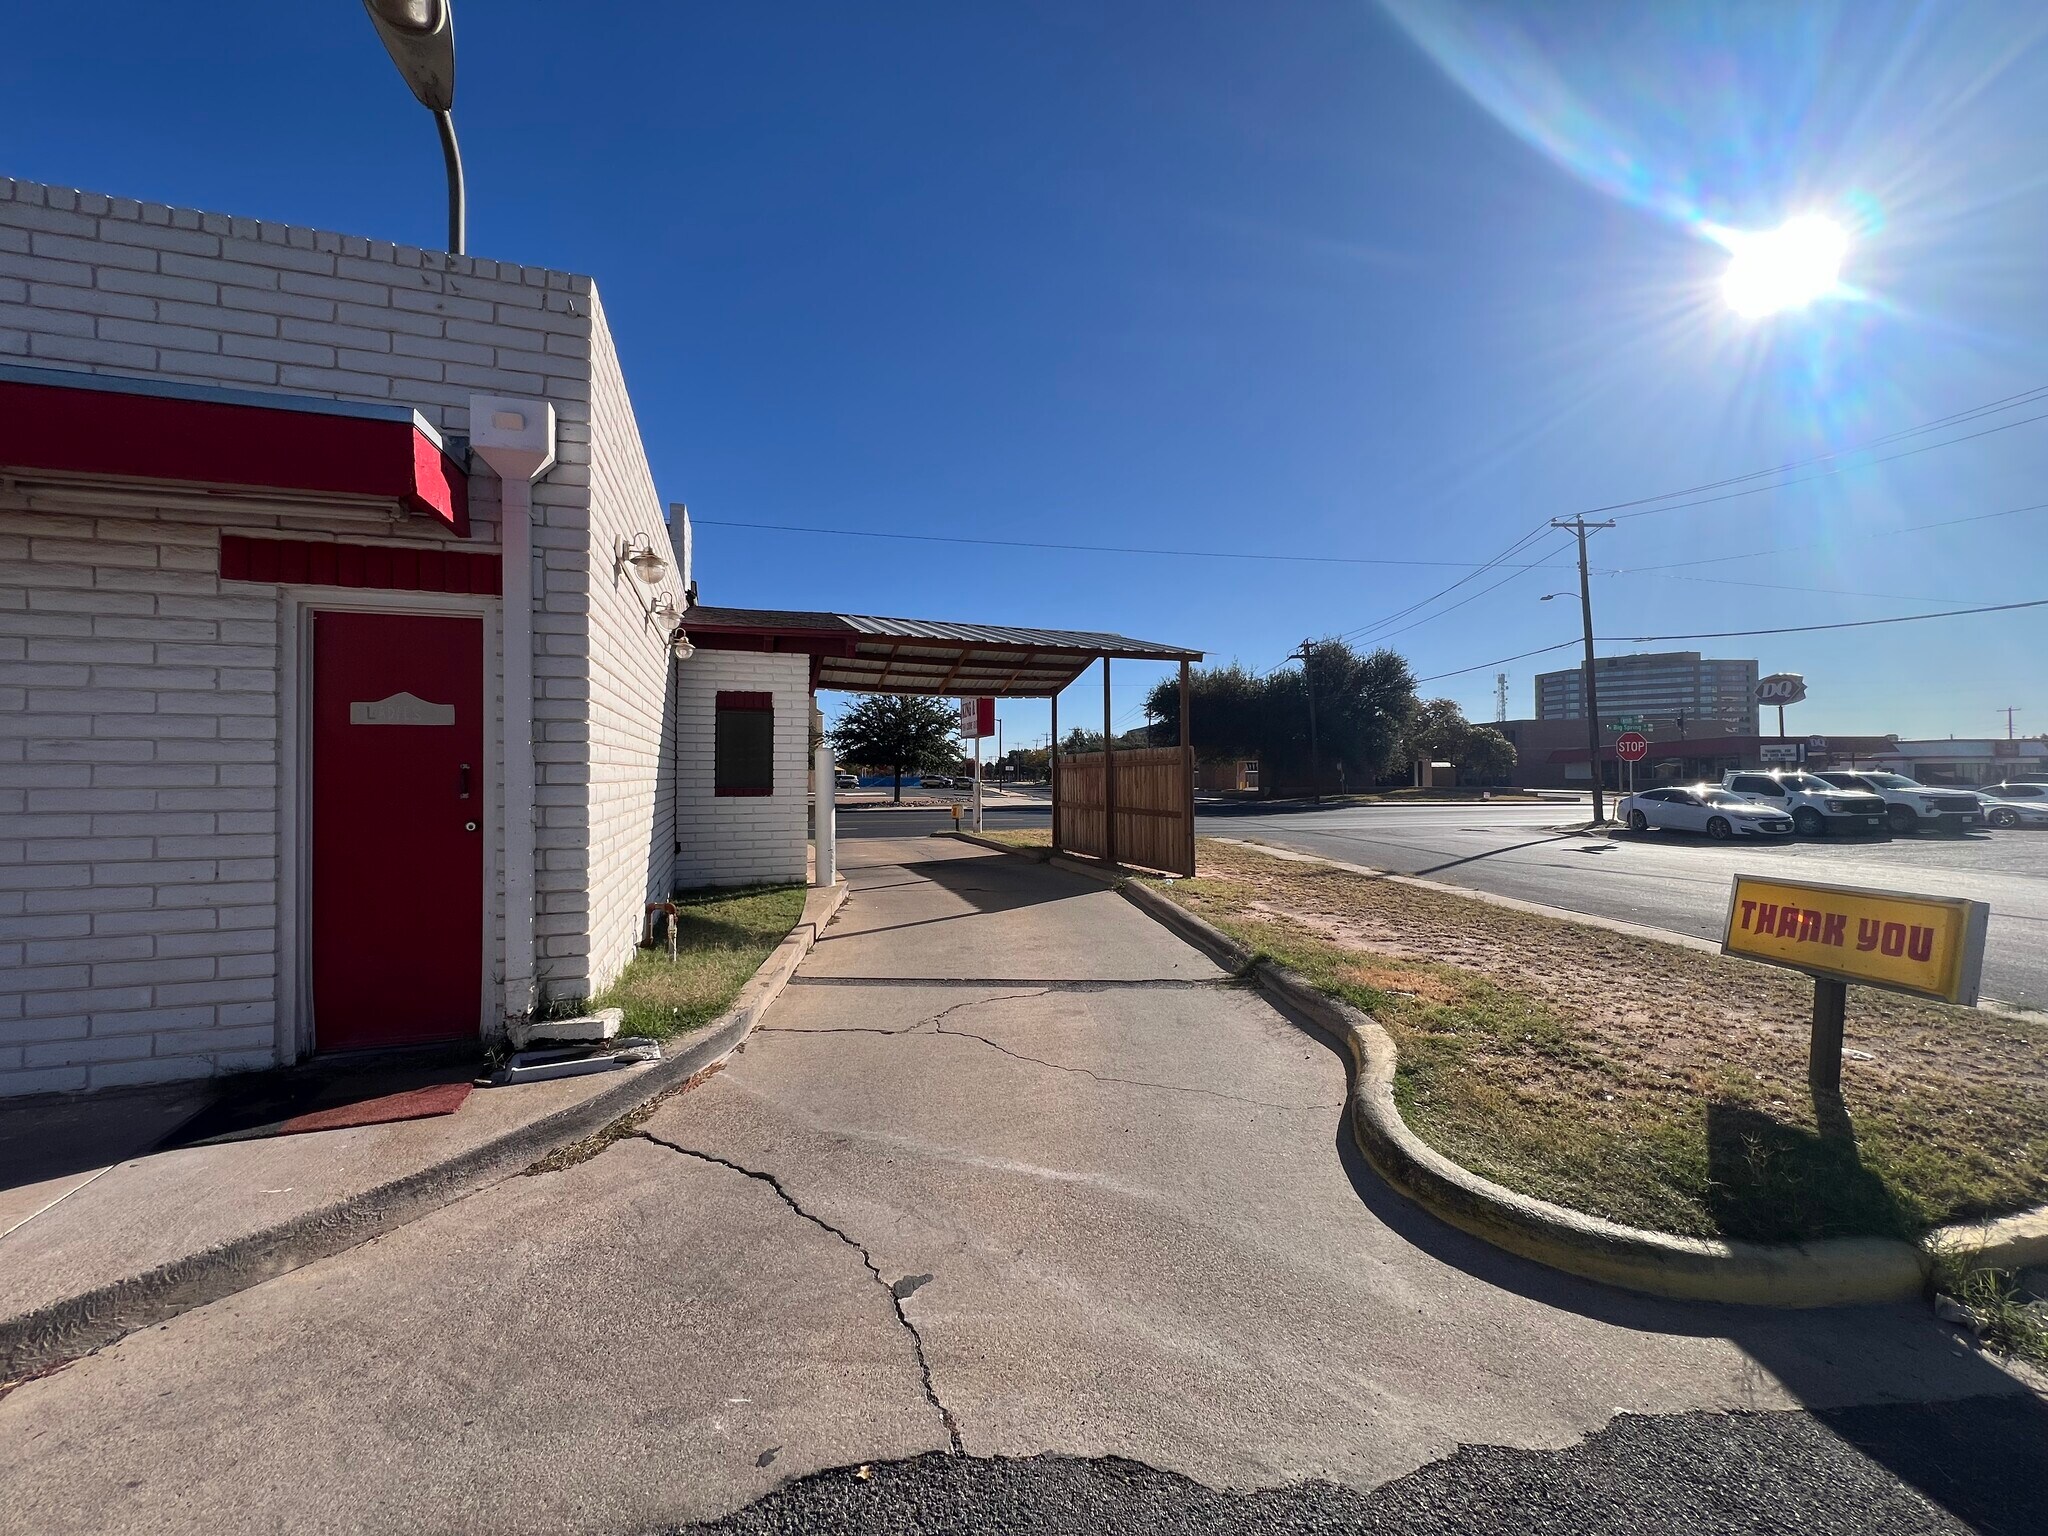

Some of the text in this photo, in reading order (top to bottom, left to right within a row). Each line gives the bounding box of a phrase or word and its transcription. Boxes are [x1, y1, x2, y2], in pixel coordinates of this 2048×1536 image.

[1762, 680, 1792, 698] DQ
[1618, 741, 1645, 752] STOP
[1809, 738, 1826, 747] DQ
[1741, 899, 1935, 962] THANK YOU
